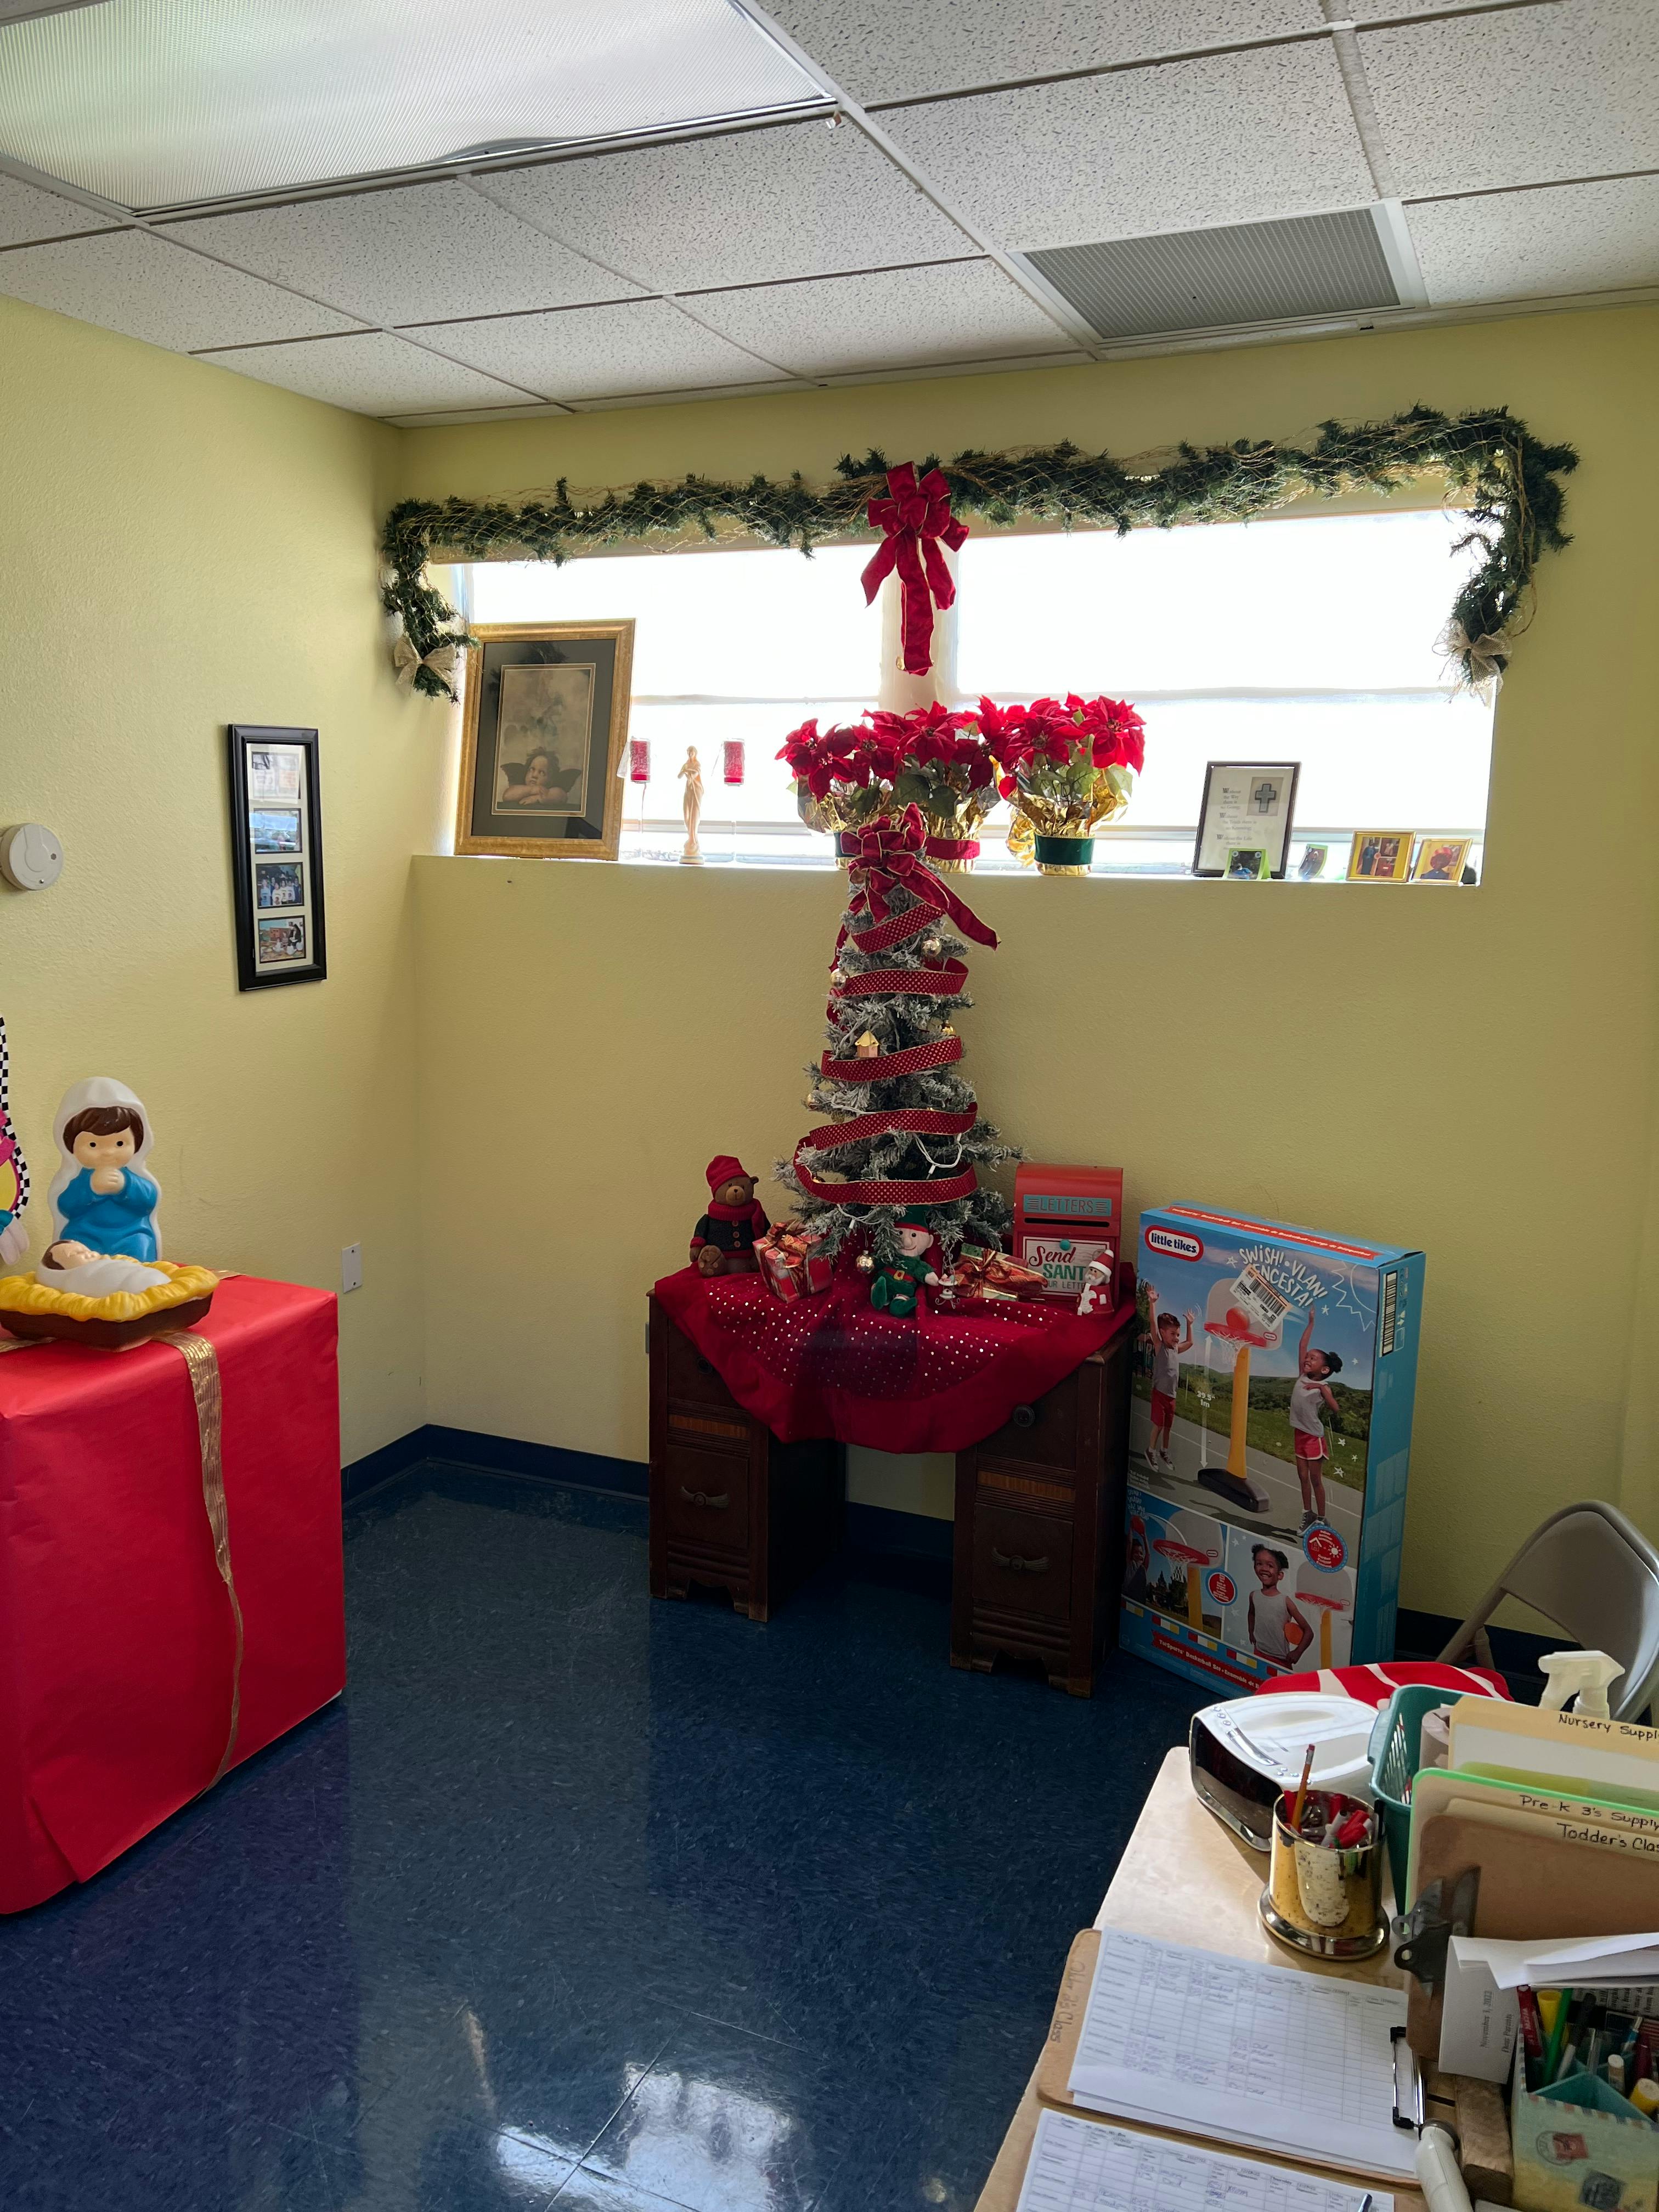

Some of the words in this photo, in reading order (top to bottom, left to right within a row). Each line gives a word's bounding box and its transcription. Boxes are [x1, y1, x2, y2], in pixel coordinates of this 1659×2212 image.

[1040, 1198, 1093, 1214] LETTERS
[1151, 1232, 1172, 1247] little
[1173, 1239, 1197, 1253] tikes
[1029, 1245, 1076, 1267] Send
[1042, 1263, 1086, 1281] SANT
[1292, 1260, 1328, 1299] VLAN!
[1062, 1281, 1085, 1289] LETTE
[1200, 1399, 1210, 1407] 1m
[1186, 1651, 1211, 1667] Basketball
[1212, 1664, 1221, 1672] Set
[1558, 1714, 1611, 1734] Nursery
[1620, 1725, 1659, 1741] Suppl
[1582, 1807, 1602, 1818] 3's
[1556, 1822, 1627, 1848] Todder's
[1050, 2011, 1073, 2044] Class
